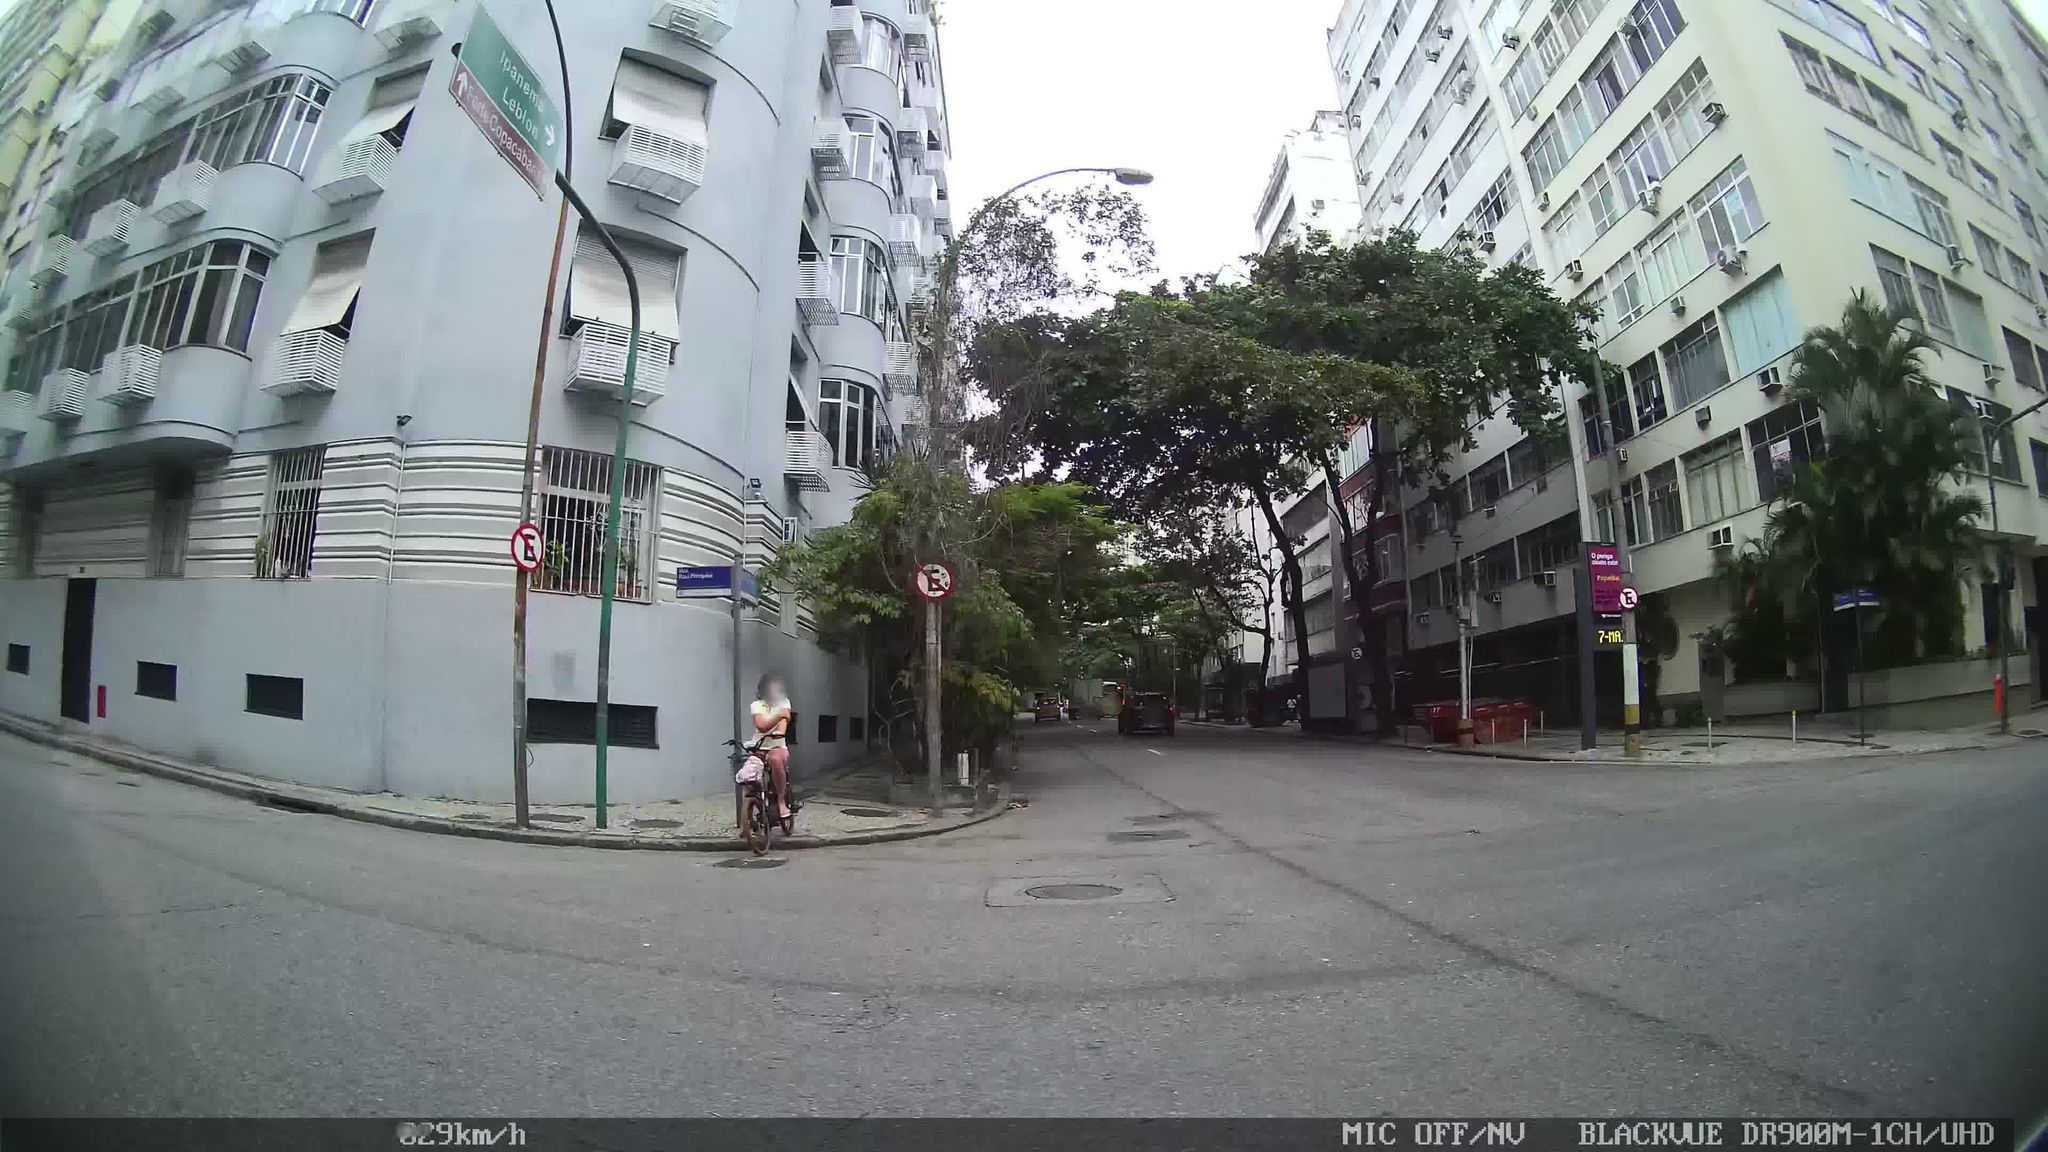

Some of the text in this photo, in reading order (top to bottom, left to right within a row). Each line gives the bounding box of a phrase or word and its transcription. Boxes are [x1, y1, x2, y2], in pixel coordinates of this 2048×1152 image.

[500, 51, 545, 113] Ipanema
[502, 86, 538, 139] Leblon
[1598, 630, 1624, 643] 7-MA
